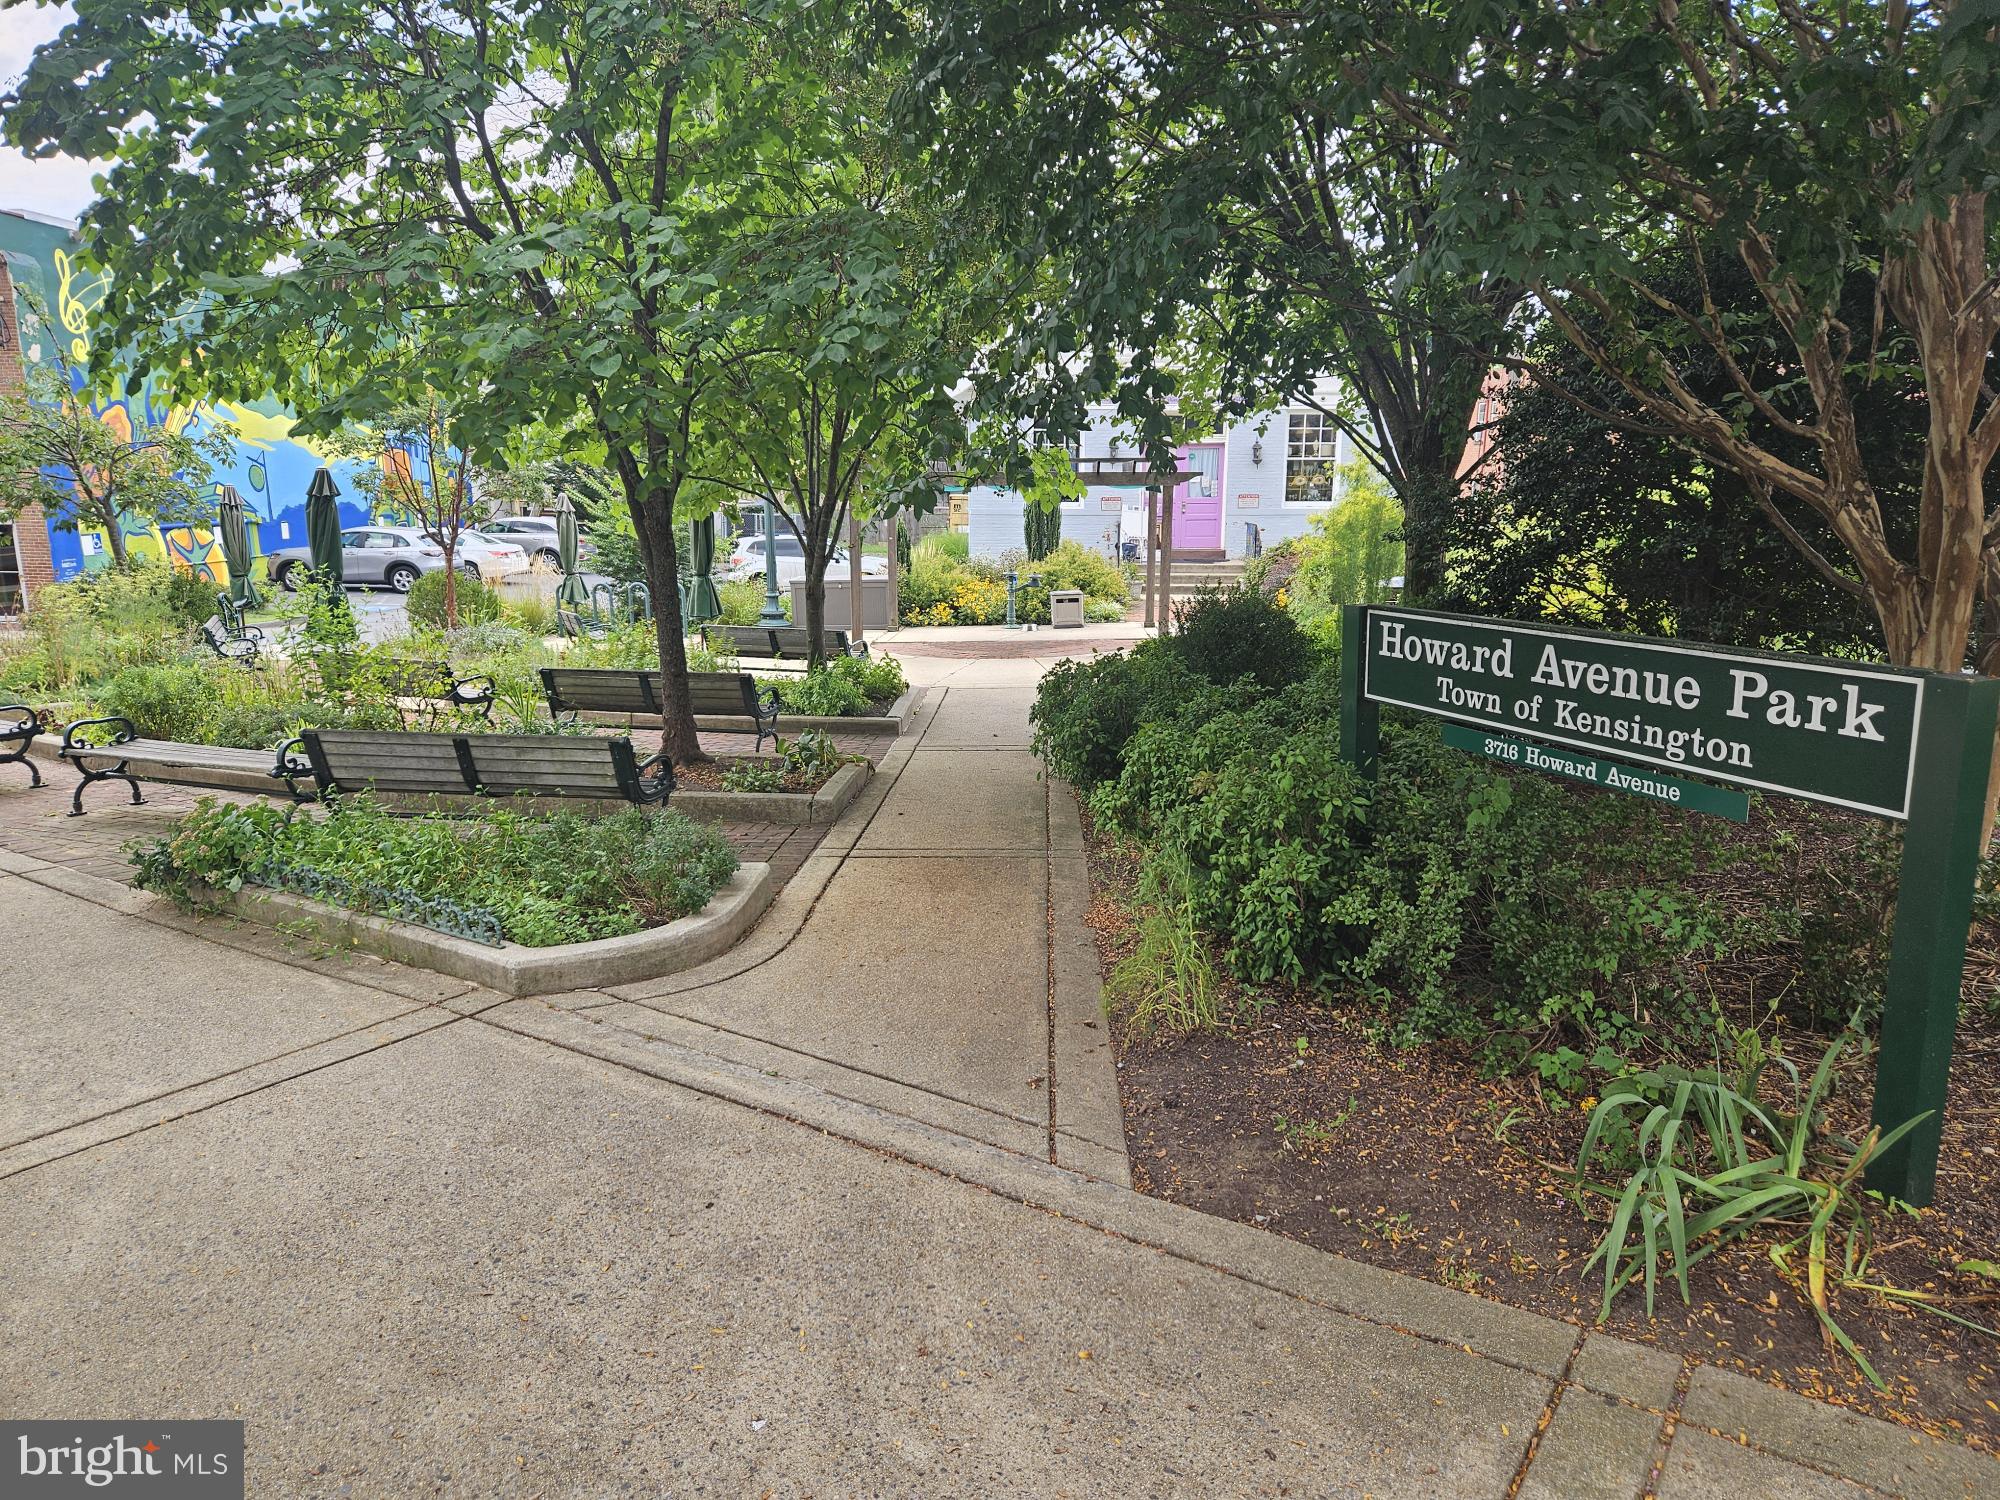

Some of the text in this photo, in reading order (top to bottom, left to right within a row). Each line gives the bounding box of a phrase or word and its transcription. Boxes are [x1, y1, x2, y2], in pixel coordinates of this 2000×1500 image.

[1379, 621, 1885, 742] Howard Avenue Park
[1437, 676, 1753, 768] Town of Kensington
[1484, 738, 1681, 801] 3716 Howard Avenue
